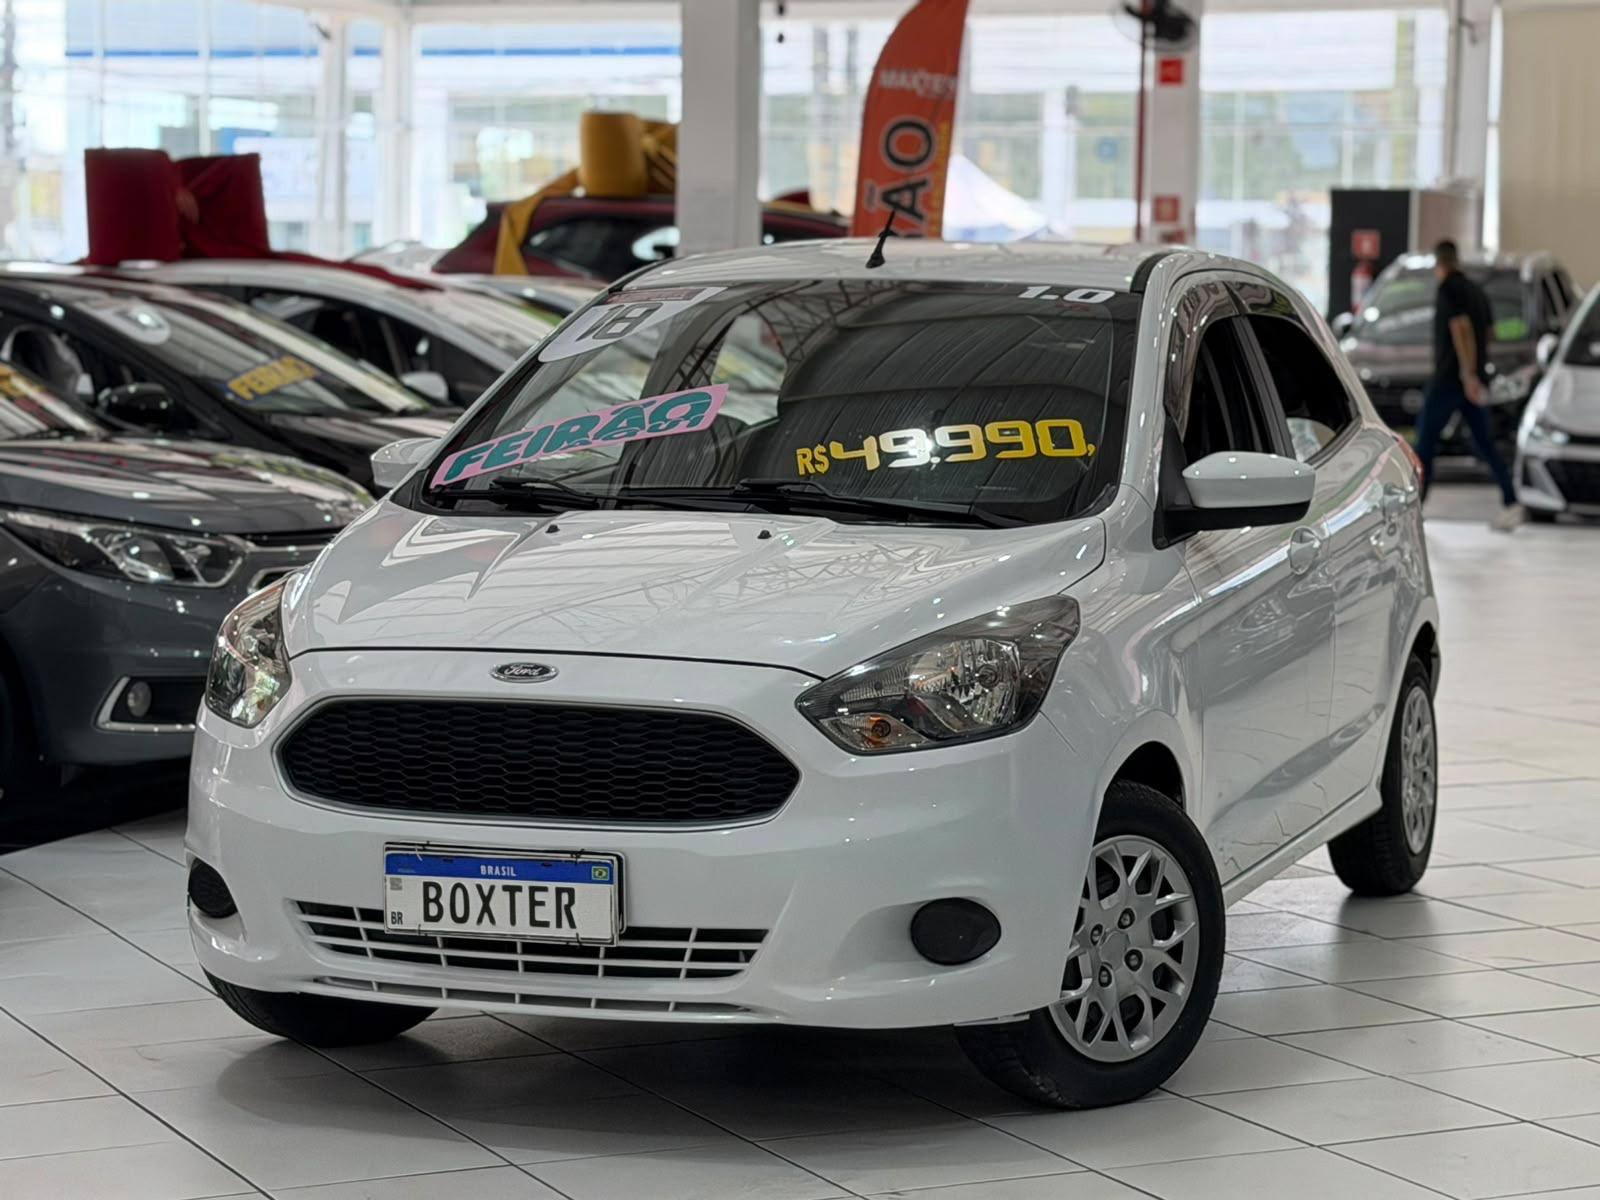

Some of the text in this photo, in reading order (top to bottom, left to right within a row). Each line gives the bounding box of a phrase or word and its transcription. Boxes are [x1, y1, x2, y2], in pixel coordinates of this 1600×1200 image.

[1018, 285, 1116, 303] 1.0
[575, 302, 664, 342] 18
[504, 665, 543, 676] Ford
[480, 864, 517, 877] BRASIL
[422, 880, 577, 930] BOXTER
[390, 911, 404, 925] BR
